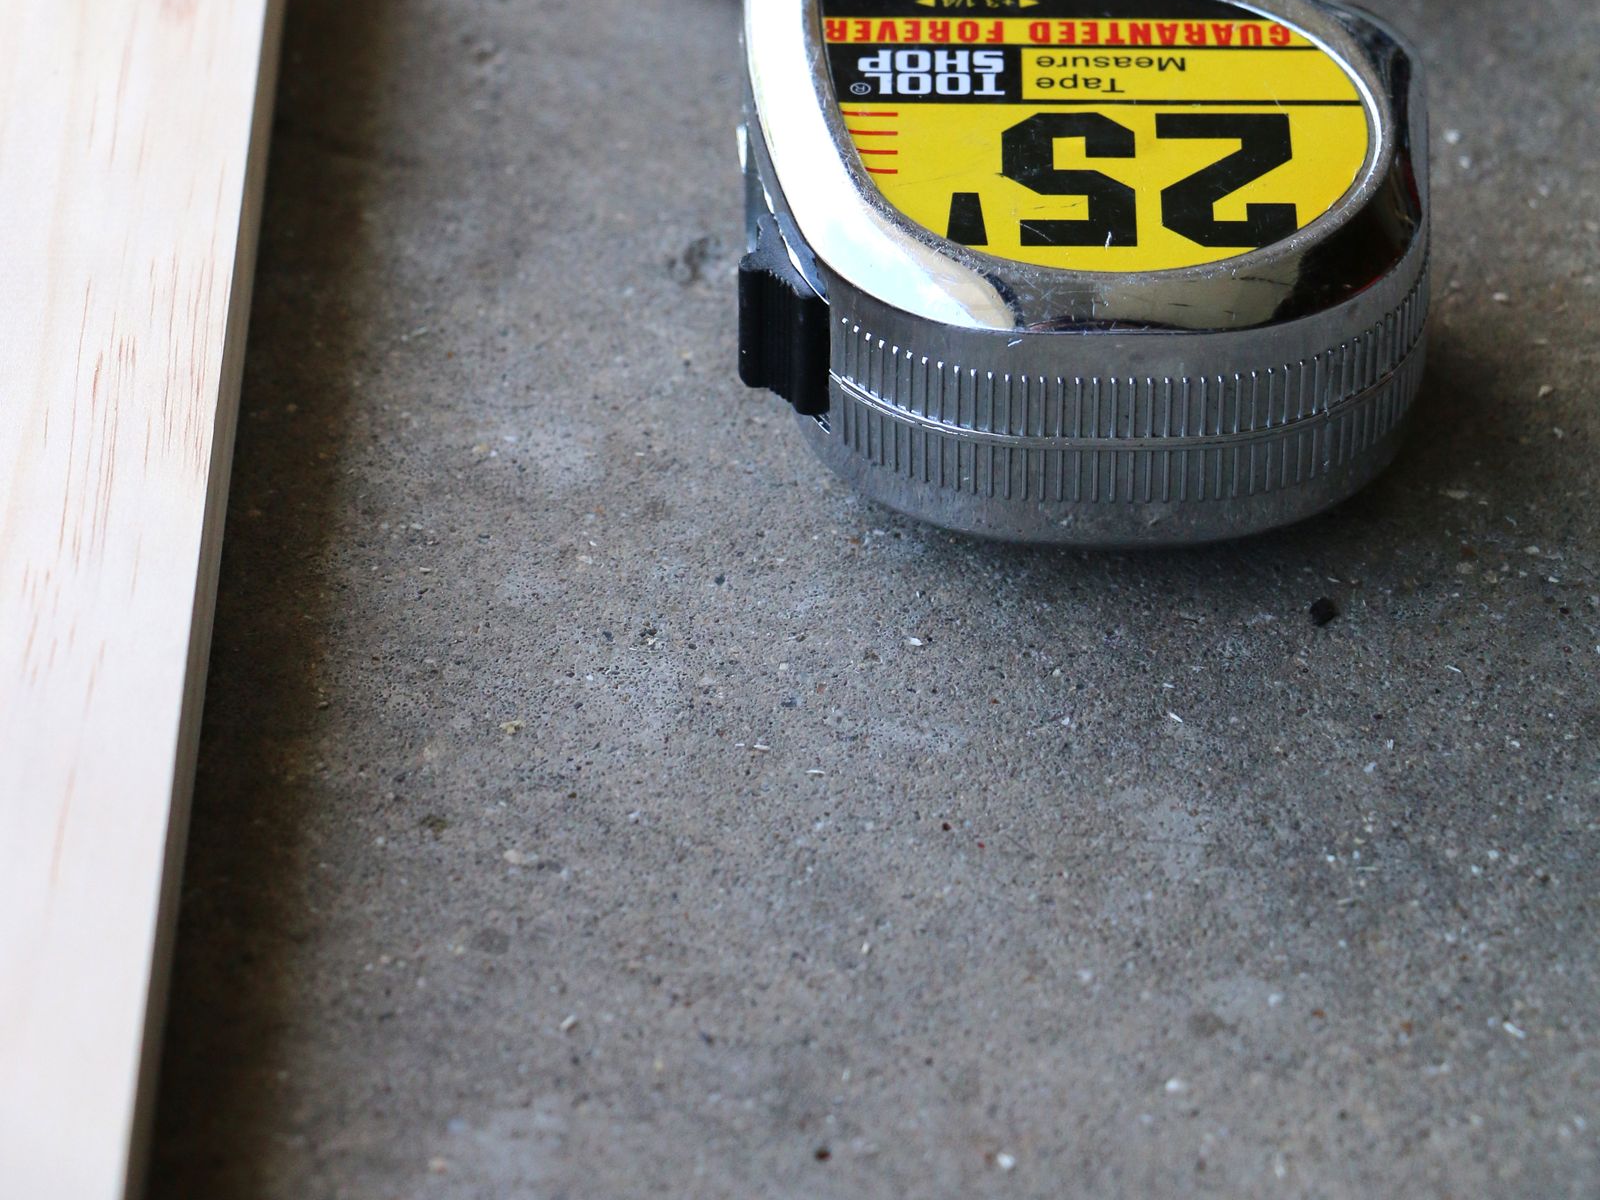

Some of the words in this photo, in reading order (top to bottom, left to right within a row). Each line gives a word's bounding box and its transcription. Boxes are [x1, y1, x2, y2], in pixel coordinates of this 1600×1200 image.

[825, 19, 1004, 43] FOREVER
[1029, 21, 1291, 46] GUARANTEED
[857, 50, 1005, 73] SHOP
[1036, 55, 1186, 72] Measure
[1036, 74, 1125, 93] Tape
[946, 112, 1298, 247] 25'
